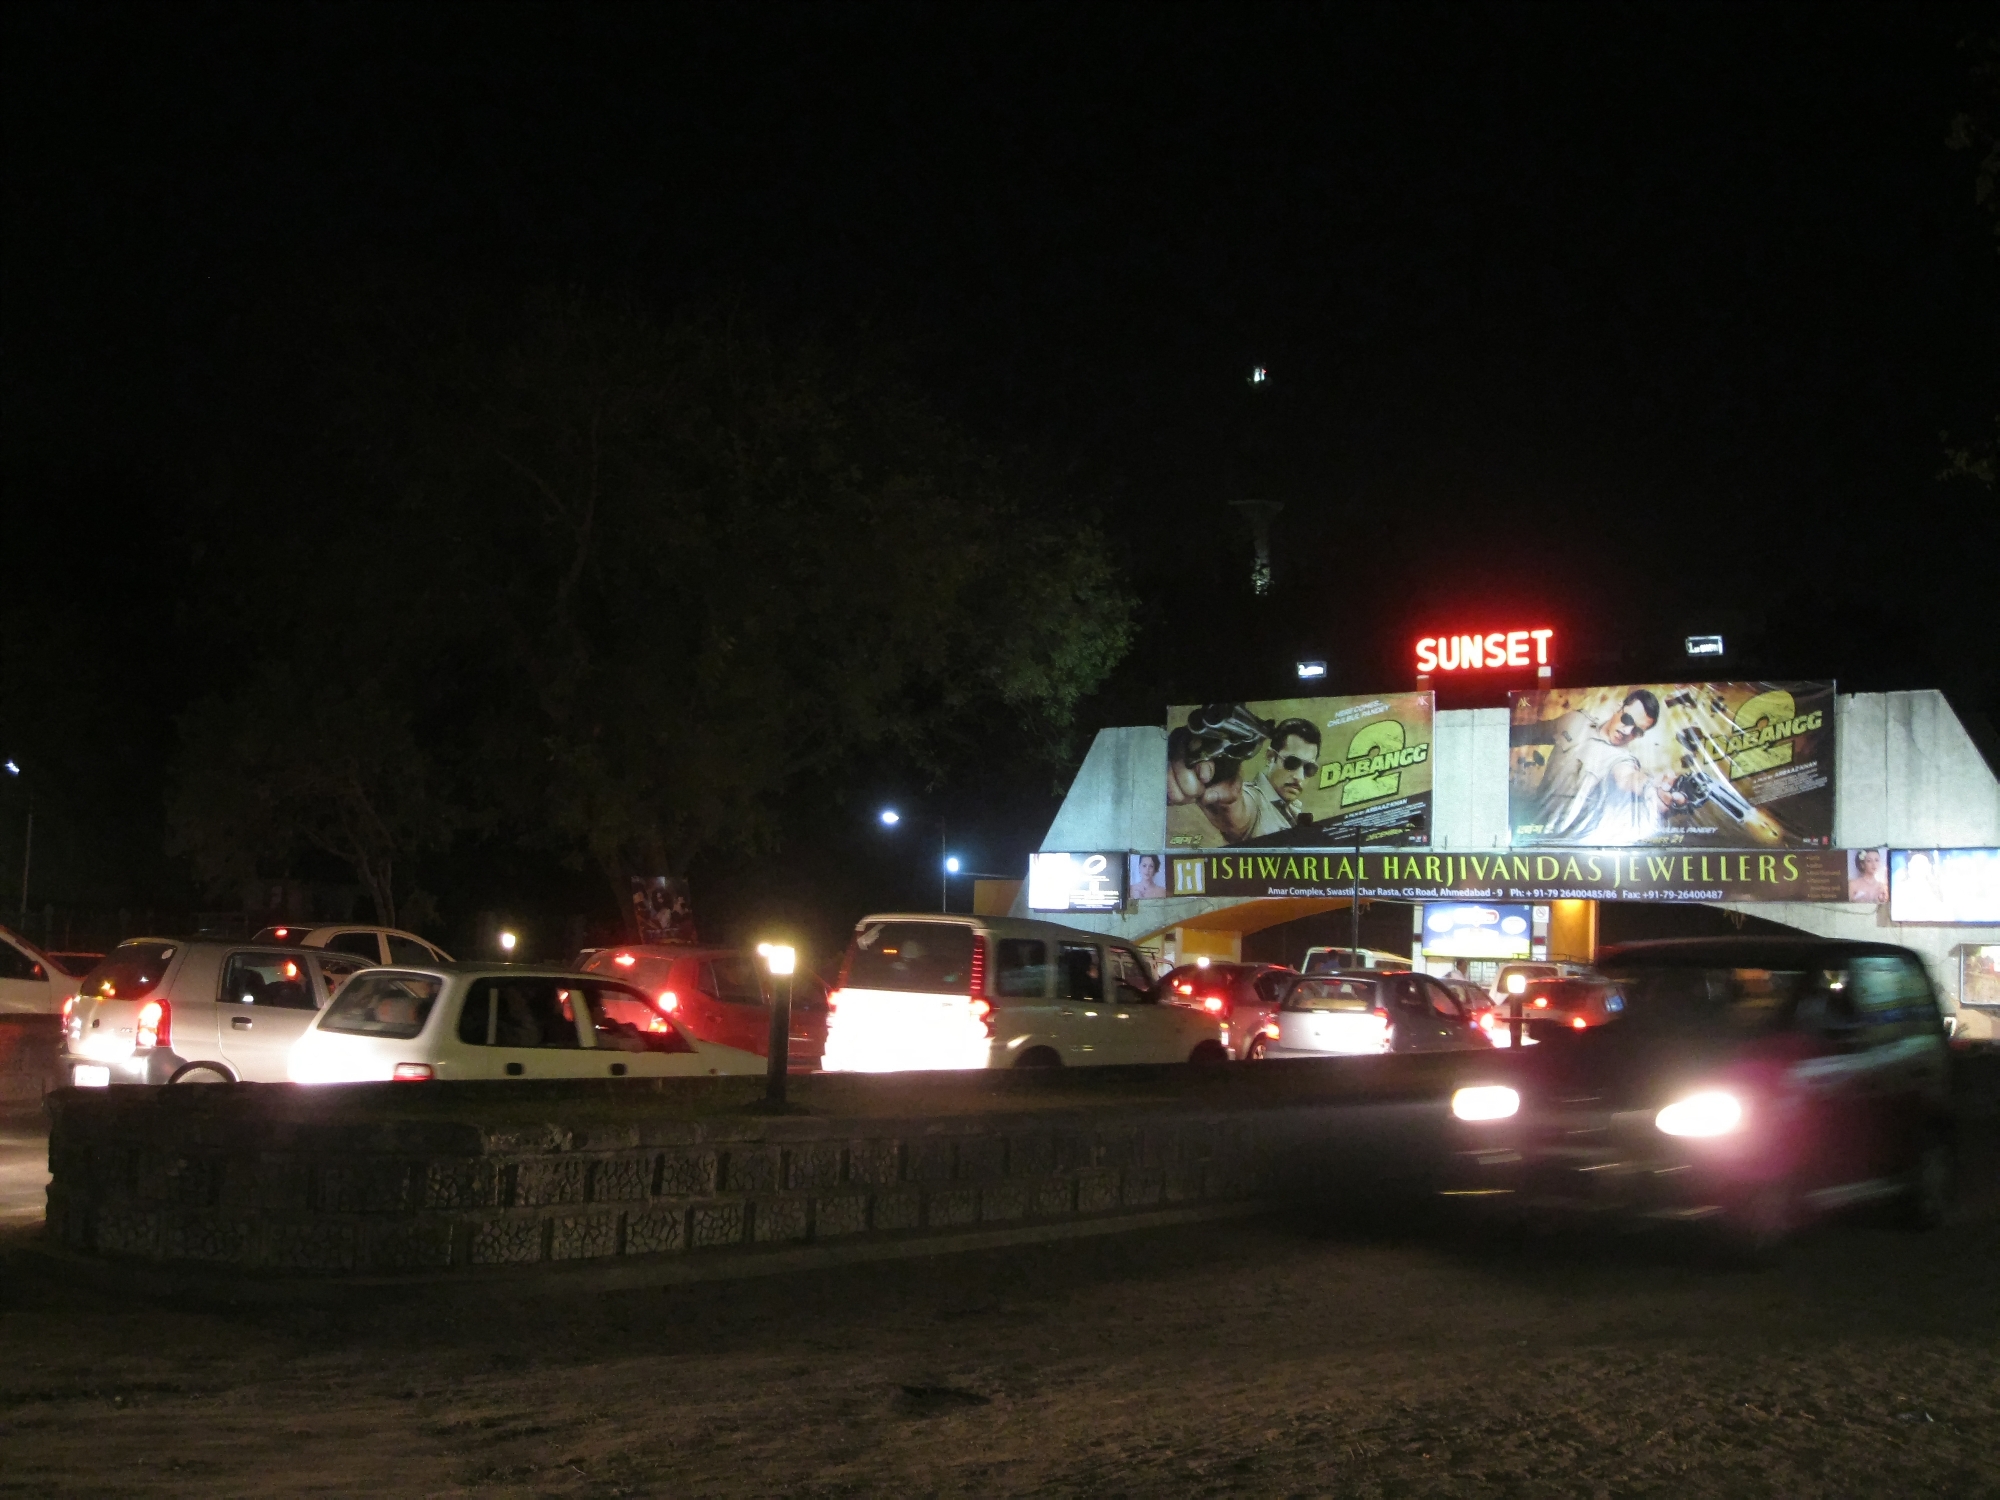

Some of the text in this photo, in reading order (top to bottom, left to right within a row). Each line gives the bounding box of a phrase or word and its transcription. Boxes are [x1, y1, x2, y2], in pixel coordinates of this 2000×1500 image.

[1416, 629, 1553, 672] SUNSET
[1703, 710, 1823, 765] DABANGG
[1318, 743, 1429, 790] DABANGG
[1340, 719, 1406, 809] 2
[1212, 854, 1799, 888] ISHWARLAL HARJIVANDAS JEWELLERS
[1268, 887, 1288, 896] Amar
[1289, 887, 1325, 898] Complex,
[1326, 886, 1356, 896] Swastik
[1358, 887, 1376, 896] Char
[1377, 887, 1401, 897] Rasta,
[1403, 888, 1414, 897] CG
[1415, 887, 1438, 898] Road,
[1440, 887, 1491, 897] Ahmedabad
[1497, 888, 1503, 897] 9
[1510, 888, 1524, 897] Ph:
[1560, 888, 1617, 899] 26400485/86
[1622, 889, 1641, 899] Fax:
[1642, 889, 1723, 900] +91-79-26400487
